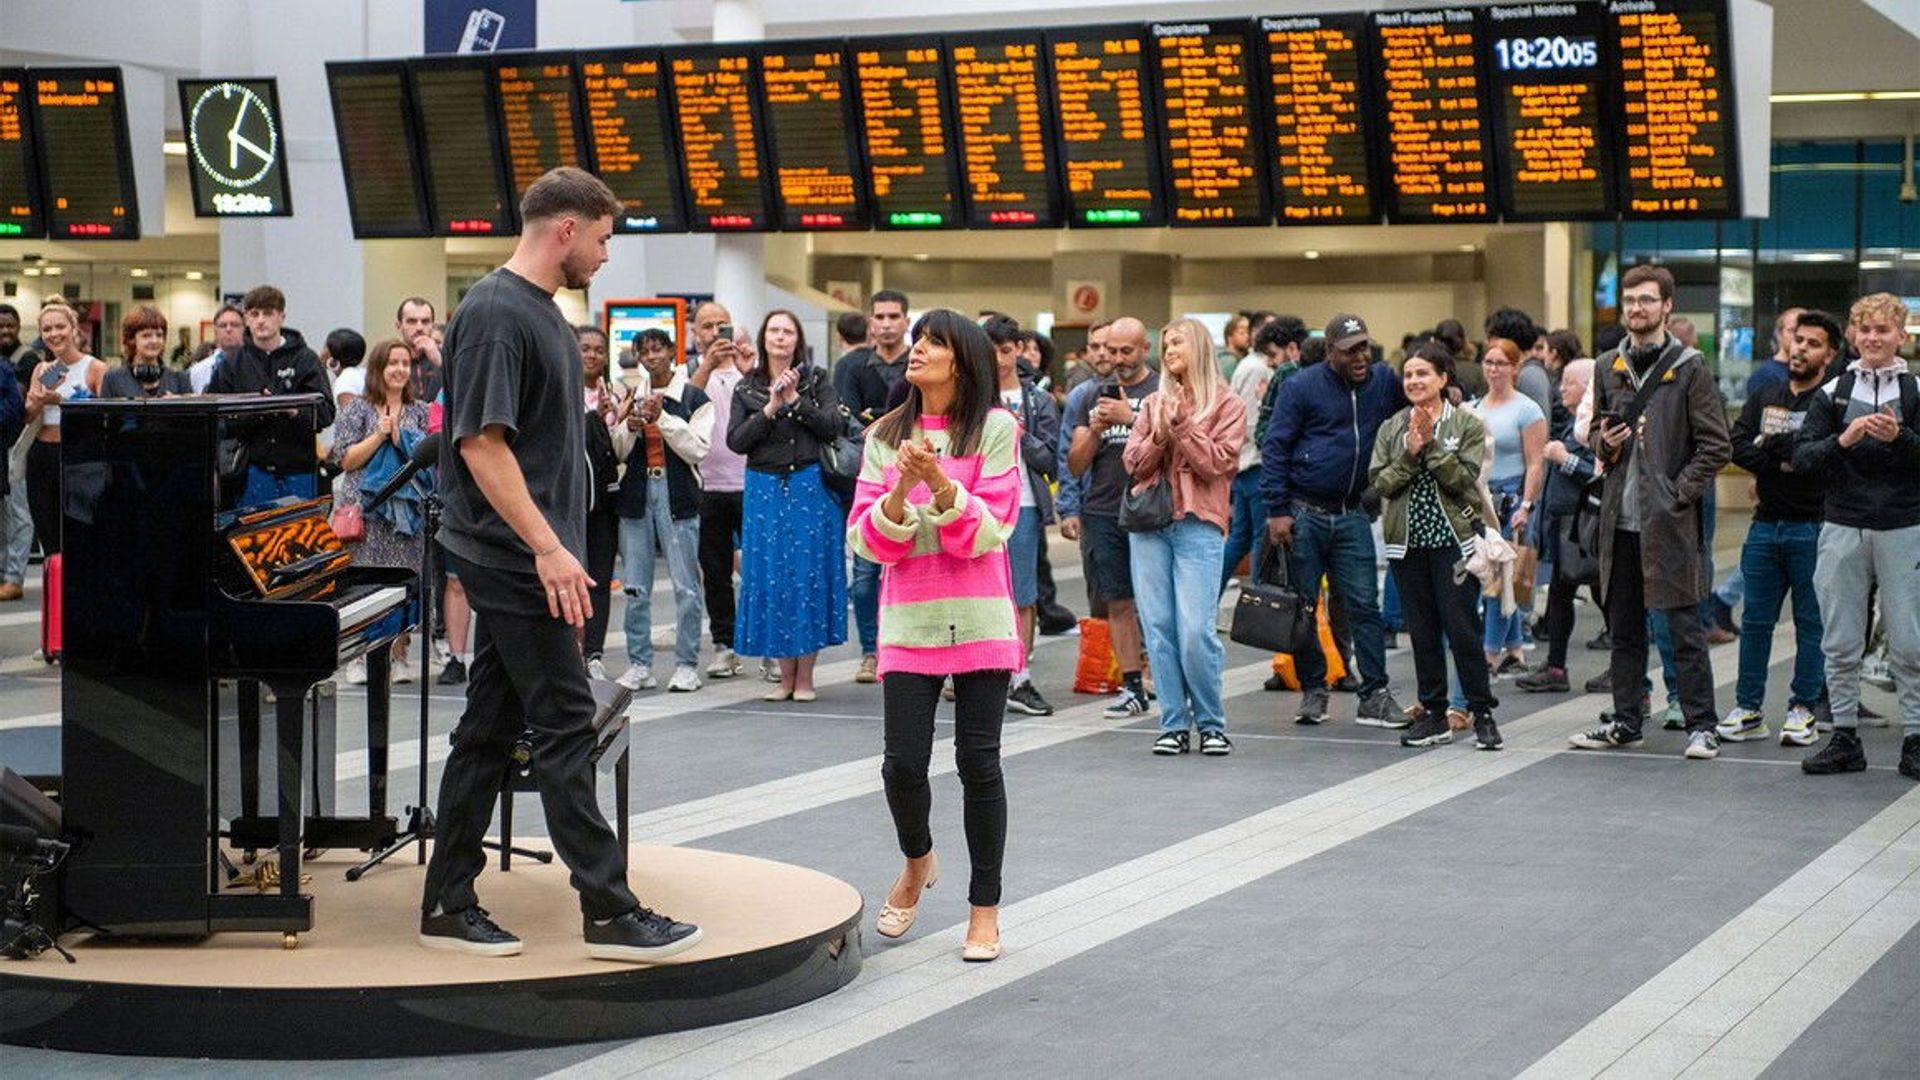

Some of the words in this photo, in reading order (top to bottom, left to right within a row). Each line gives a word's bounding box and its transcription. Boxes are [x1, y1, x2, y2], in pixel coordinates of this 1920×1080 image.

[1491, 6, 1532, 22] Special
[1534, 4, 1577, 17] Notices
[1610, 0, 1656, 13] Arrivals
[1376, 12, 1401, 25] Next
[1403, 10, 1443, 23] Fastest
[1445, 8, 1473, 21] Train
[1152, 24, 1210, 36] Departures
[1262, 18, 1320, 31] Departures
